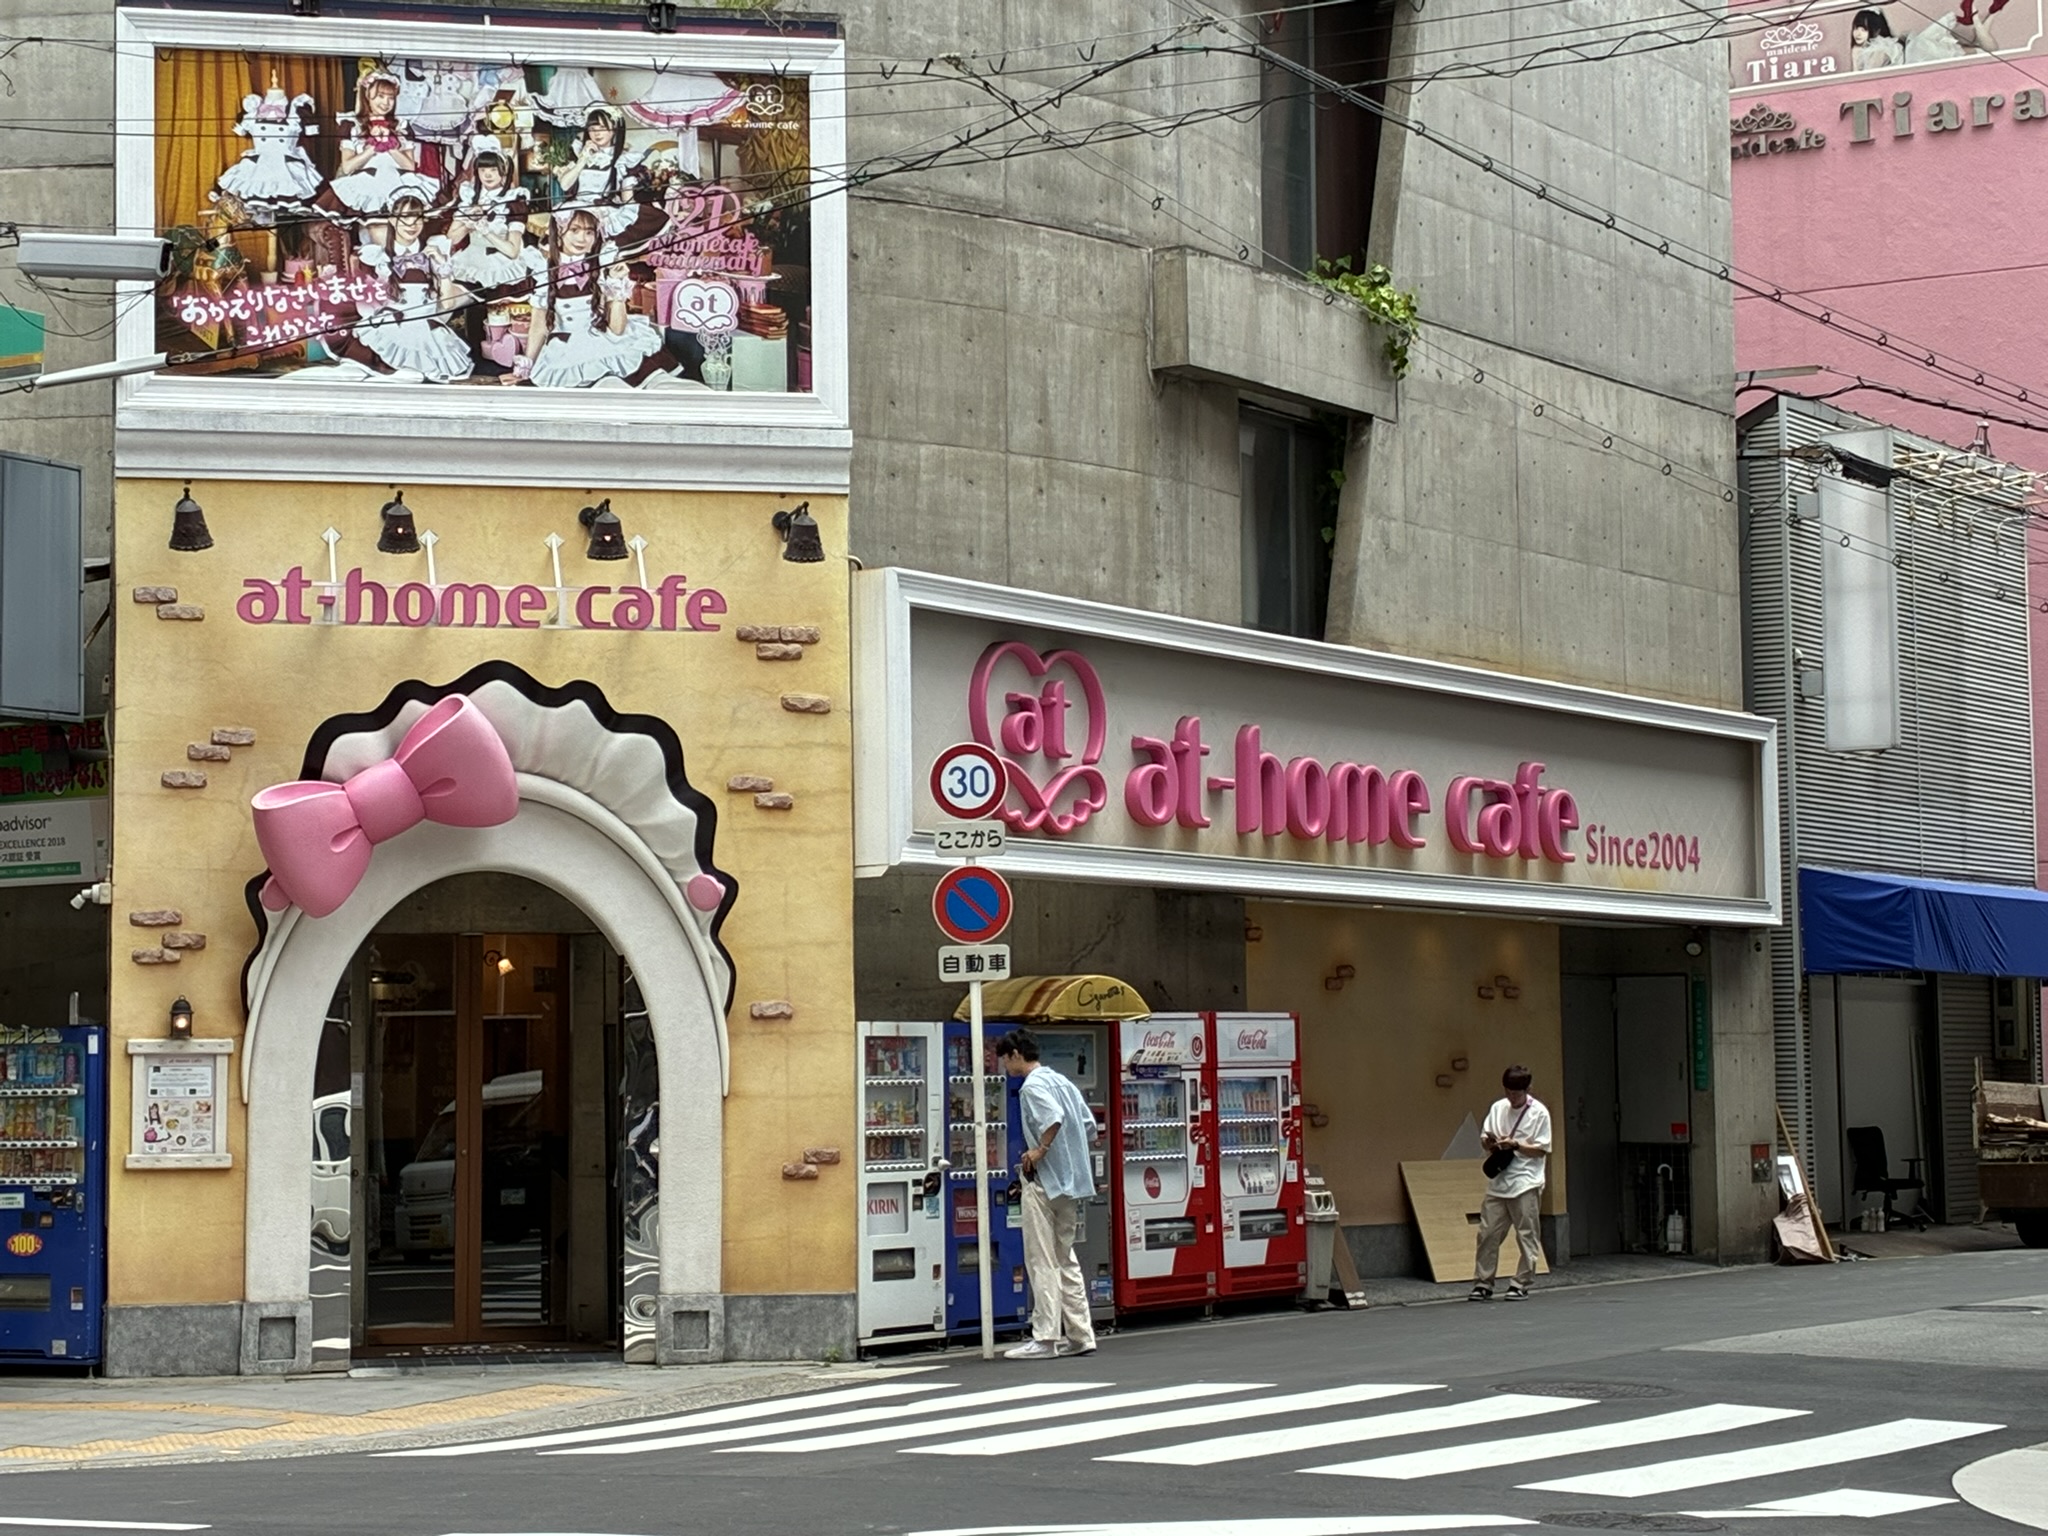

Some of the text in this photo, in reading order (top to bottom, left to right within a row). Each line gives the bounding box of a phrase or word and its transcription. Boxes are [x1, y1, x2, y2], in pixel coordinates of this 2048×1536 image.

[1766, 42, 1819, 57] maidcafe
[1746, 56, 1837, 83] Tiara
[754, 90, 774, 103] at
[1840, 88, 2048, 144] Tiara
[690, 293, 718, 313] at
[236, 566, 728, 631] at-home cafe
[1001, 680, 1072, 759] at
[948, 765, 989, 799] 30
[1125, 715, 1579, 863] at-home cafe
[47, 837, 66, 847] 2018
[938, 829, 1003, 849] ここから
[942, 953, 1008, 974] 自動車
[867, 1198, 899, 1216] KIRIN
